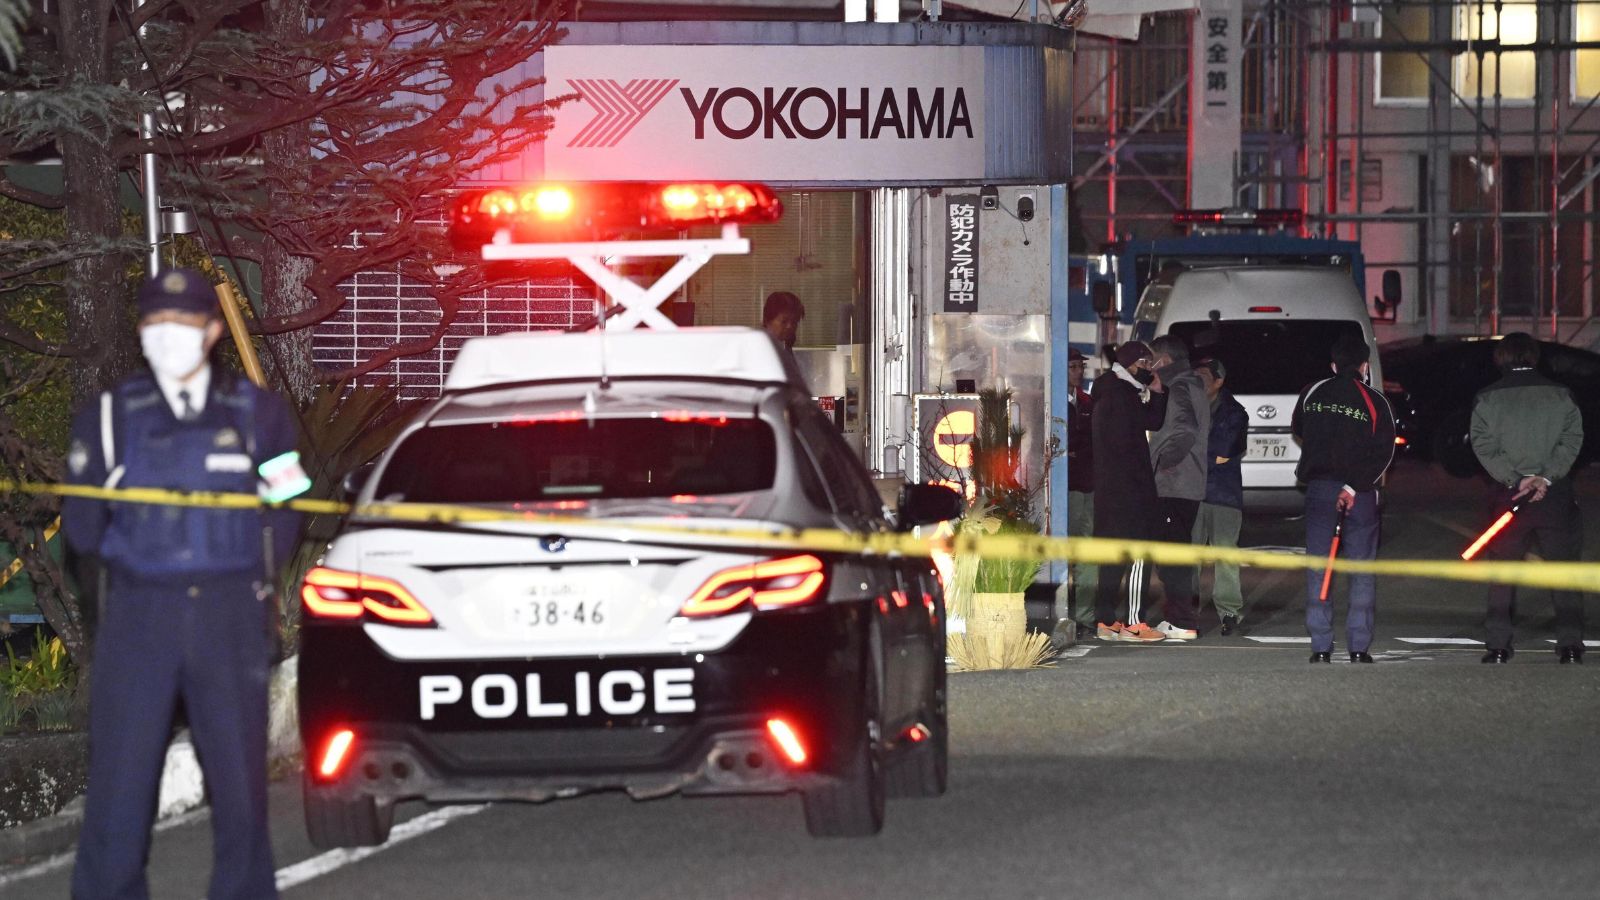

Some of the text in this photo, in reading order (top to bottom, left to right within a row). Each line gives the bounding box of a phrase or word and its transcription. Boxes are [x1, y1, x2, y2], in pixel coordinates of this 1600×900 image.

[1207, 18, 1228, 107] 安全第一
[680, 87, 974, 140] YOKOHAMA
[949, 204, 975, 304] 防犯カメラ作動中
[419, 668, 696, 720] POLICE
